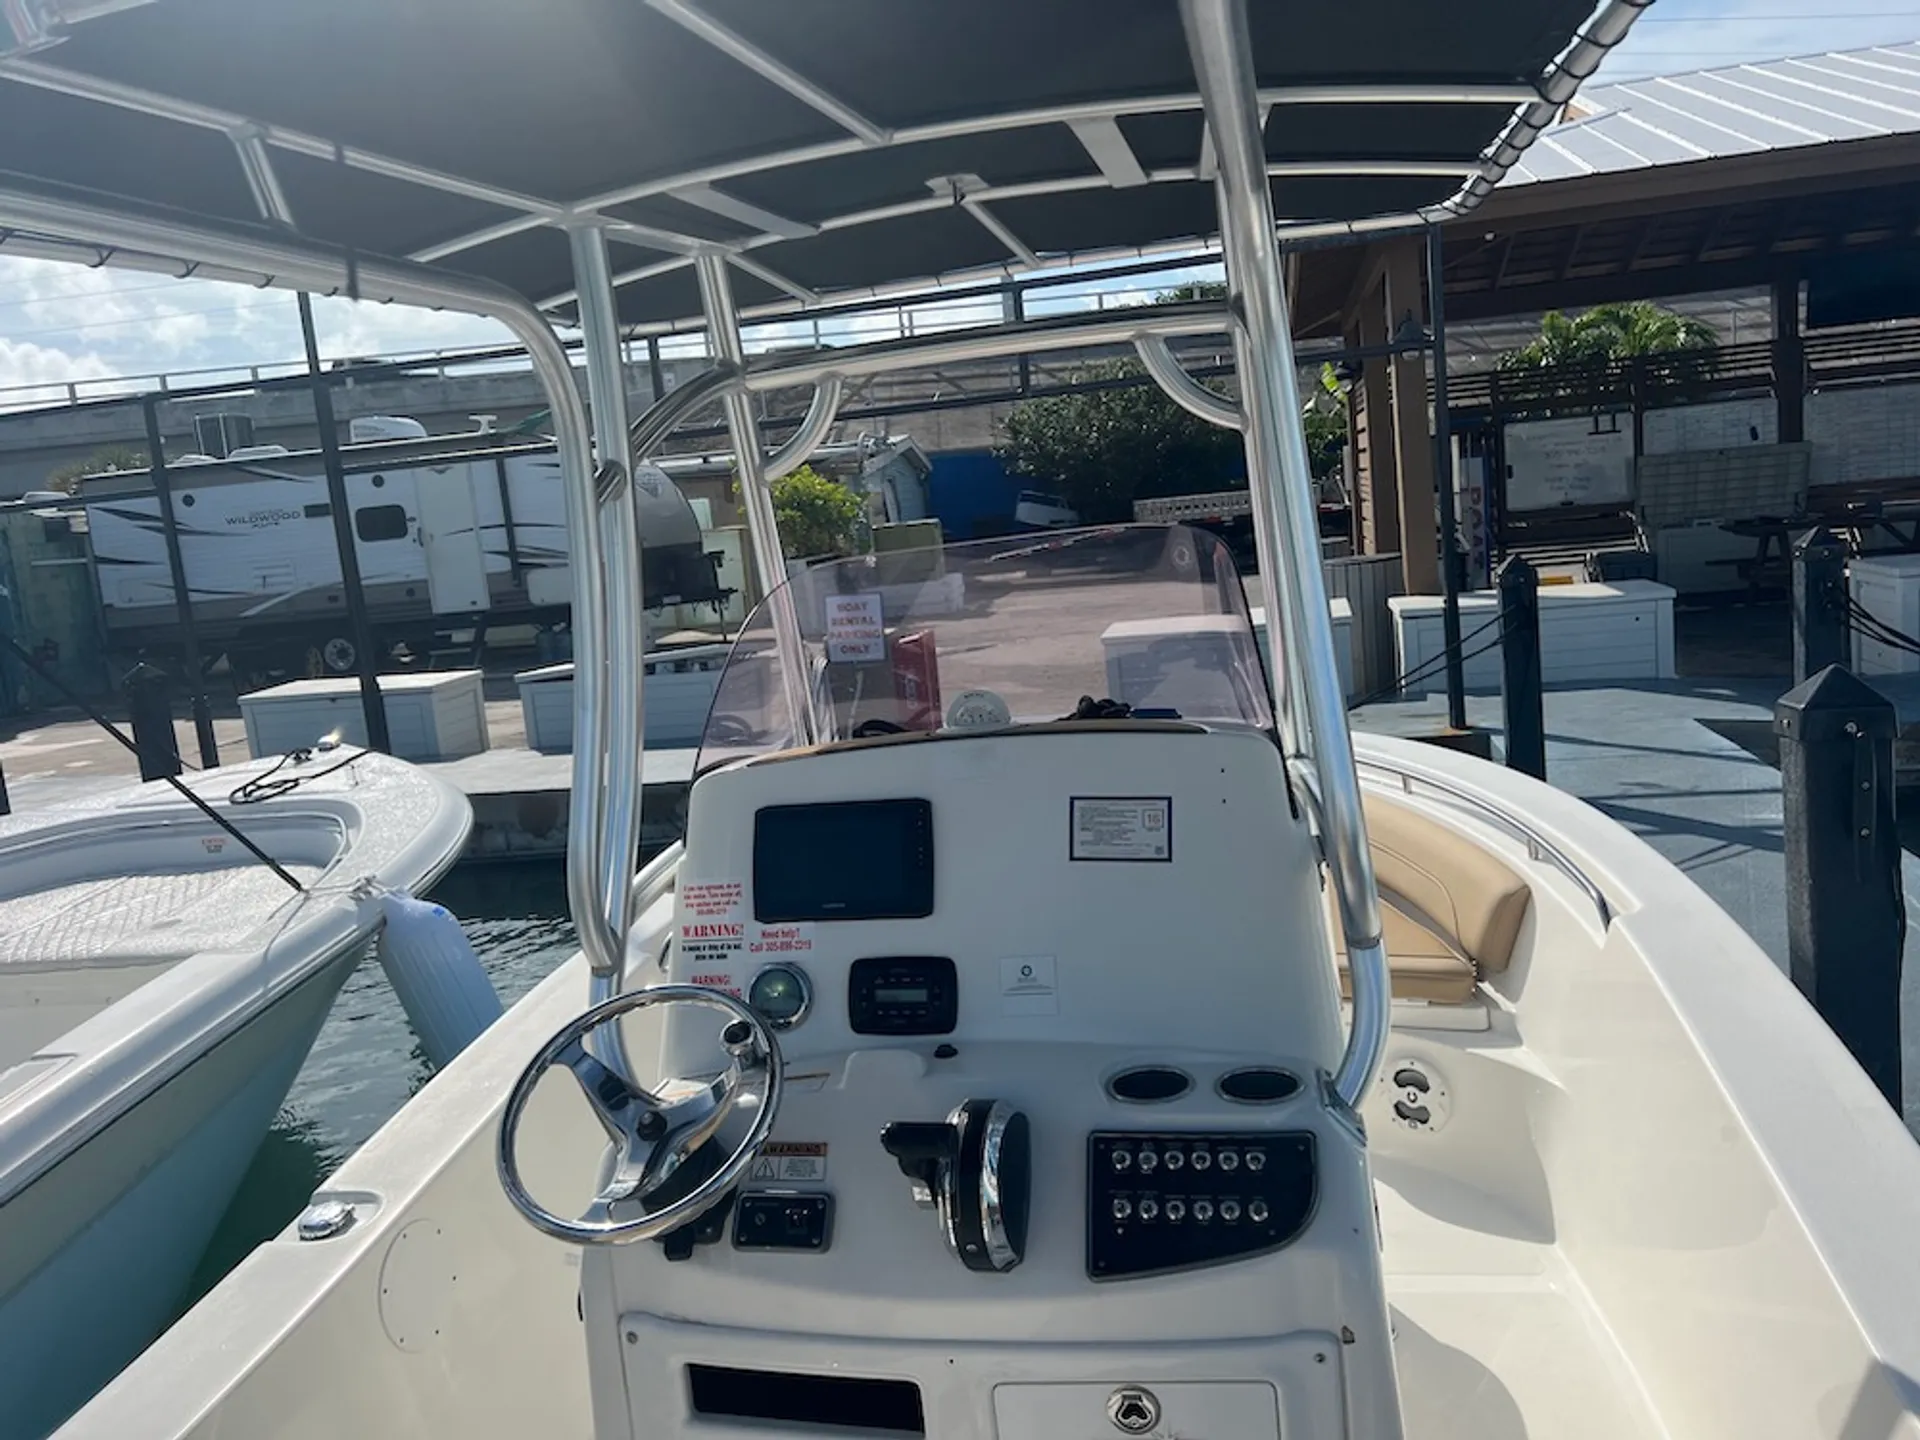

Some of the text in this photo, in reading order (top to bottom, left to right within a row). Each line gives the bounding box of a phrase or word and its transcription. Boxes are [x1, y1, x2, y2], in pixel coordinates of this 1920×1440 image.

[224, 510, 300, 525] WILDWOOD
[836, 602, 868, 612] BOAT
[831, 616, 876, 626] RENTAL
[840, 643, 870, 654] ONLY
[682, 923, 744, 937] WARNING!
